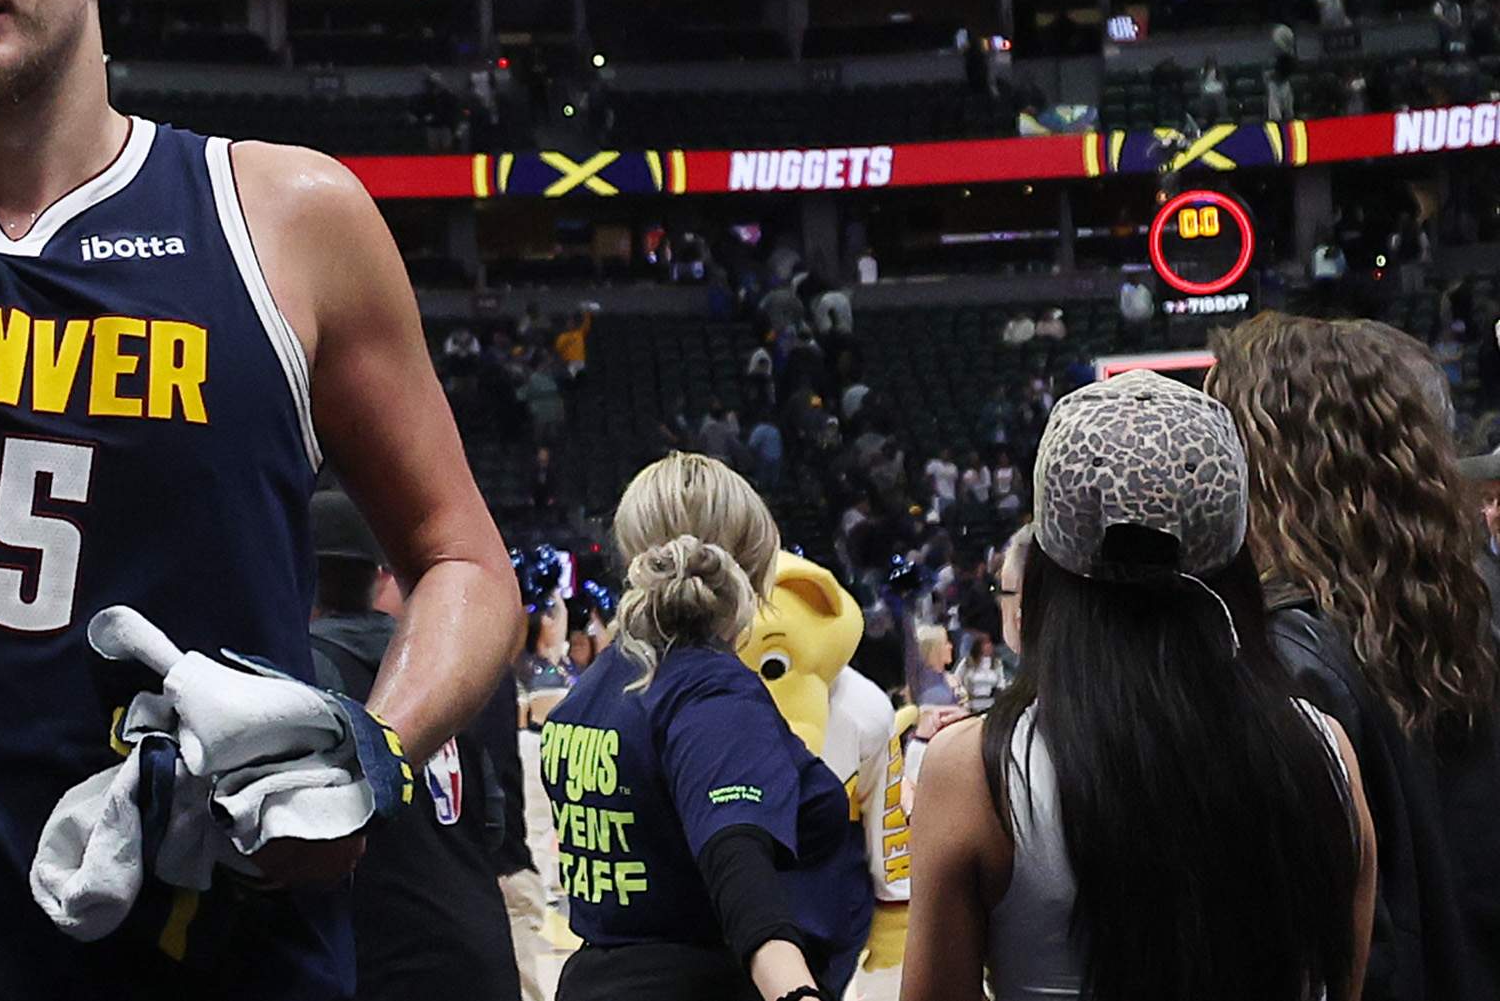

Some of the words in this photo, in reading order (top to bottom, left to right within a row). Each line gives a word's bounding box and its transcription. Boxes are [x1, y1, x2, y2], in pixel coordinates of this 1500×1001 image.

[1394, 102, 1500, 155] NUGG
[729, 145, 893, 191] NUGGETS
[80, 235, 186, 261] ibotta
[552, 800, 634, 853] VENT
[559, 852, 648, 906] TAFF
